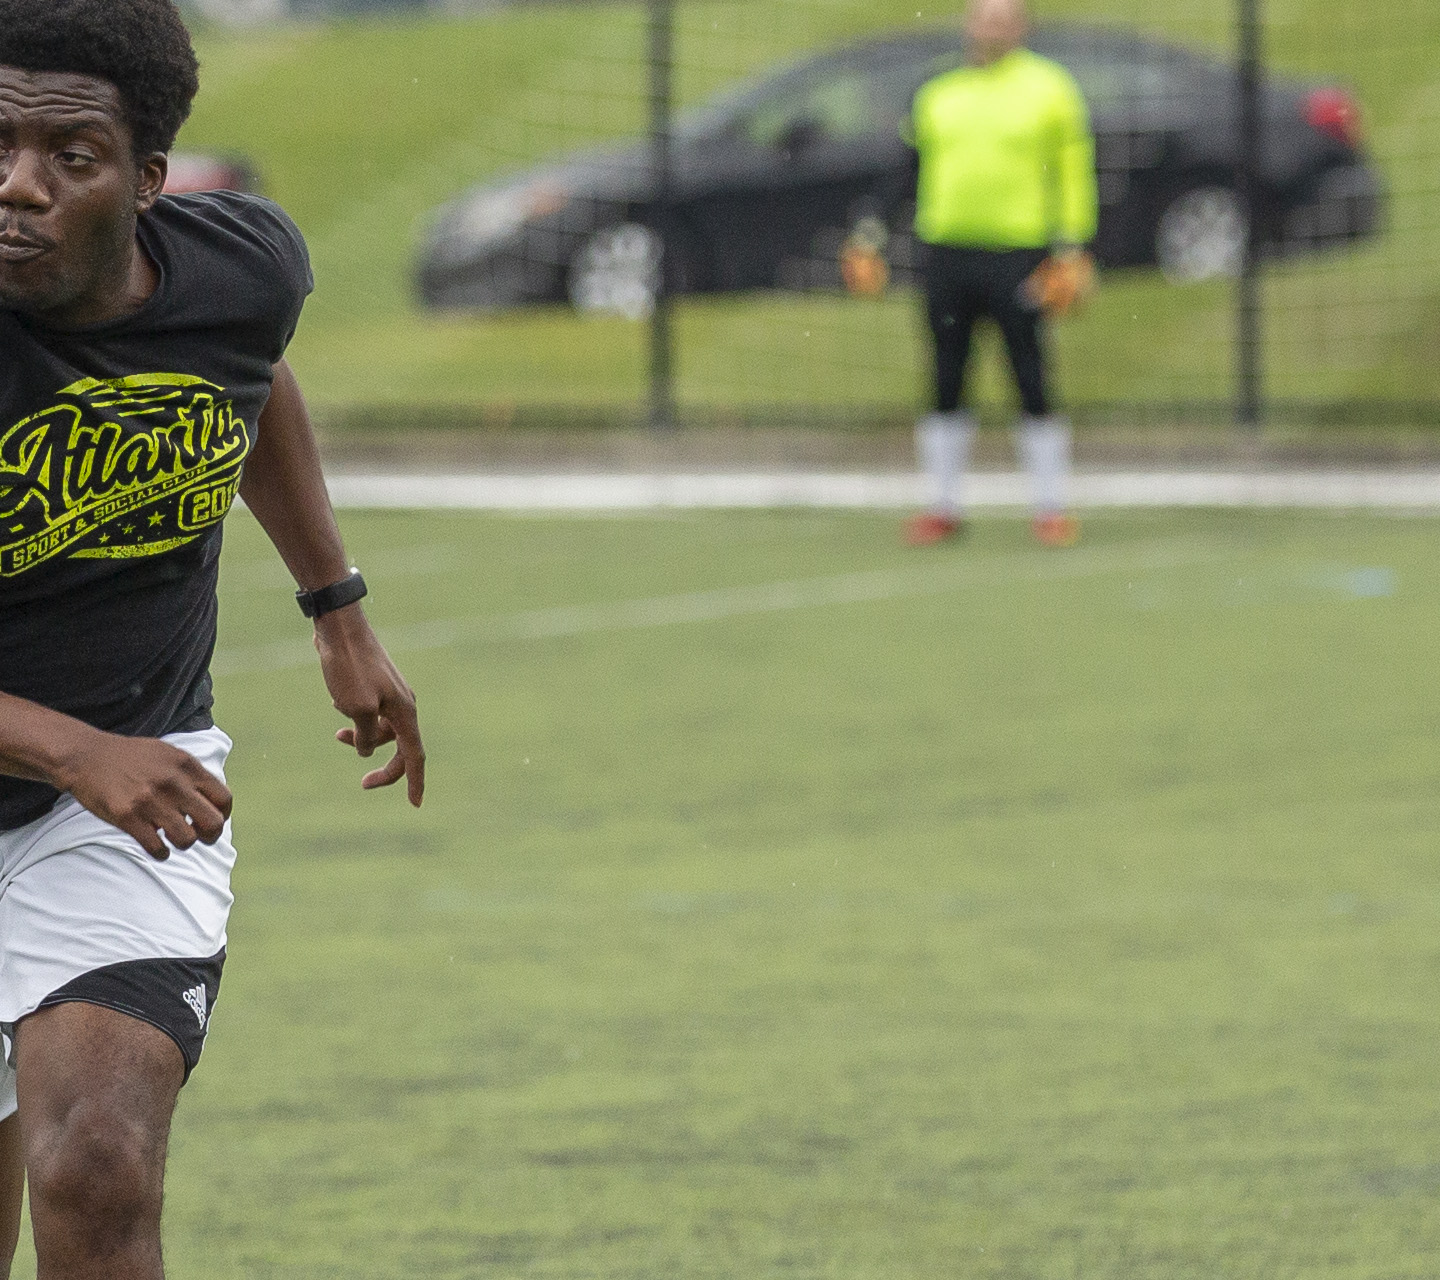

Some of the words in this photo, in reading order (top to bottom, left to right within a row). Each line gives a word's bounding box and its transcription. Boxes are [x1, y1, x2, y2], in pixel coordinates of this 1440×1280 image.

[12, 523, 71, 569] SPORT
[74, 517, 88, 532] &
[93, 487, 160, 523] SOCIAL
[162, 465, 207, 490] CLUB
